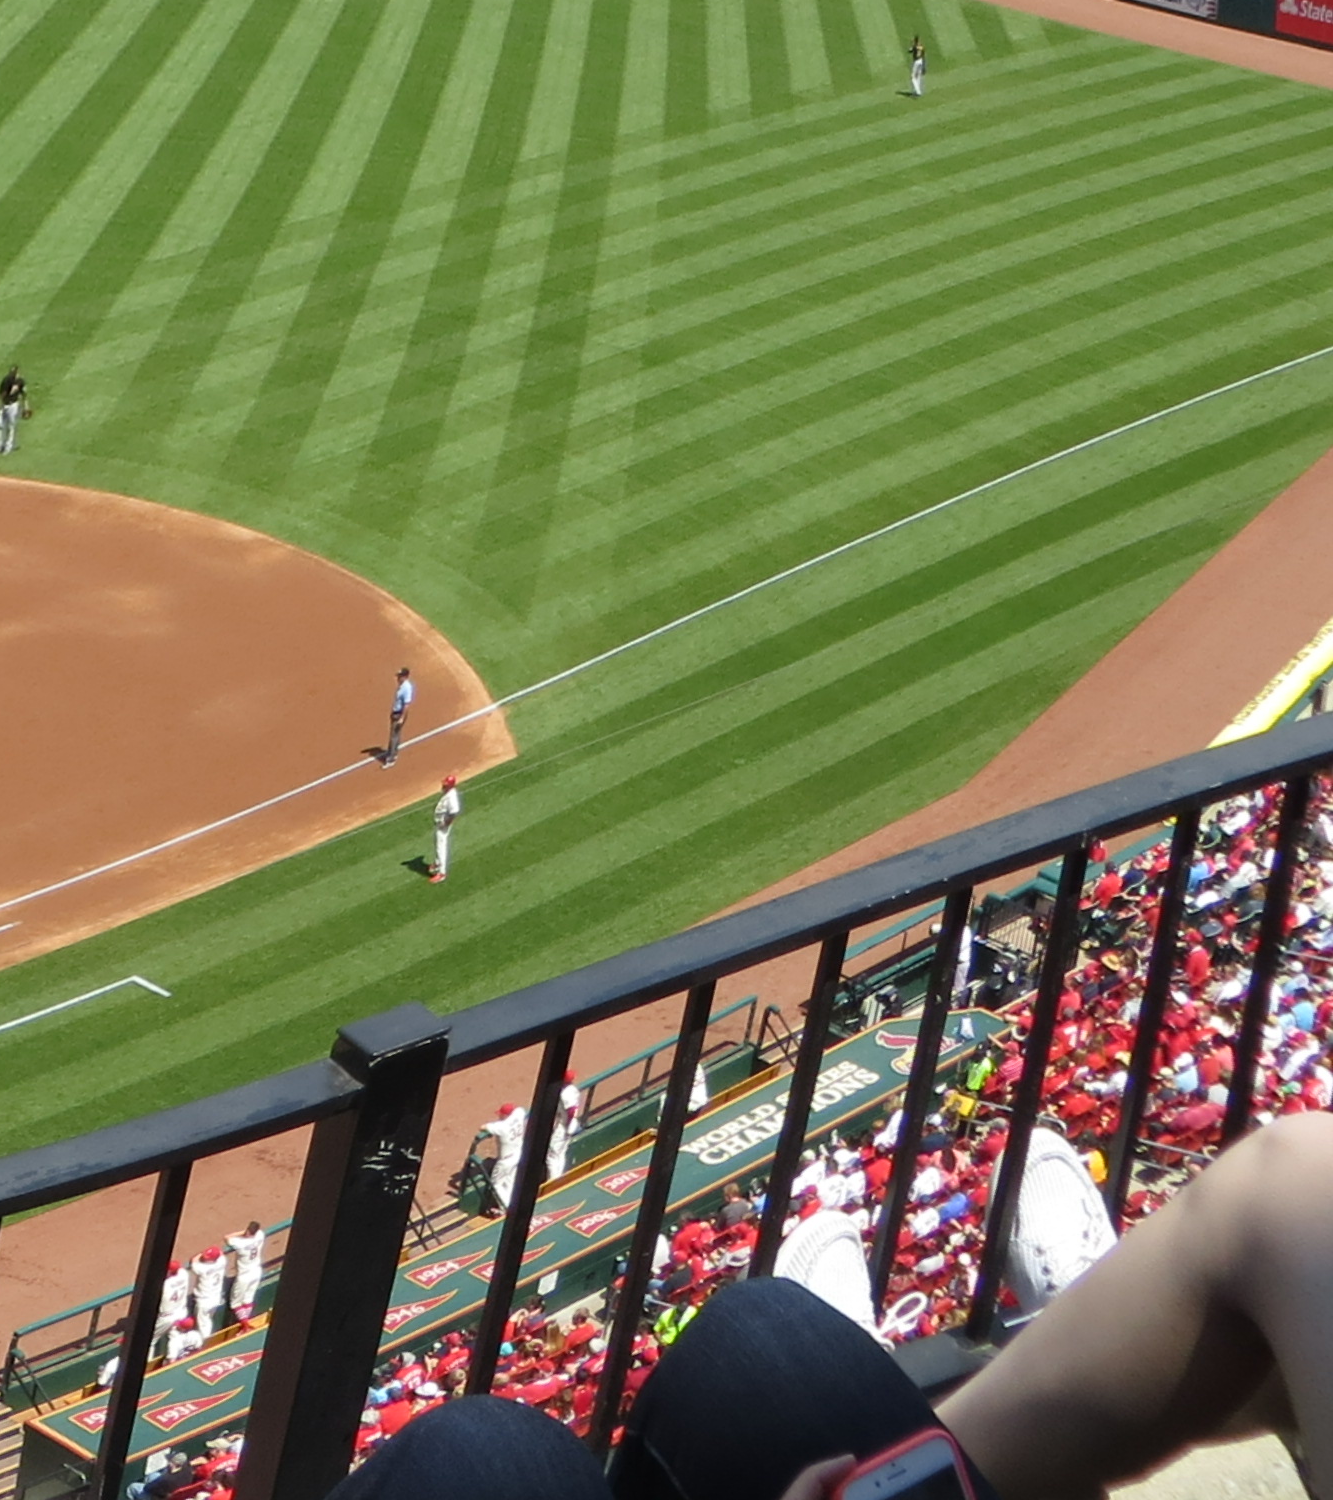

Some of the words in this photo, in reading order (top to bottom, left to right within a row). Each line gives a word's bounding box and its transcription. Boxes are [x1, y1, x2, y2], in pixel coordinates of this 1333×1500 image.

[1299, 0, 1332, 23] State
[679, 1104, 778, 1156] WORLD
[605, 1172, 637, 1191] 2011
[575, 1210, 618, 1232] 2006
[415, 1259, 461, 1283] 1964
[201, 1357, 246, 1378] 1934
[156, 1404, 199, 1423] 1931
